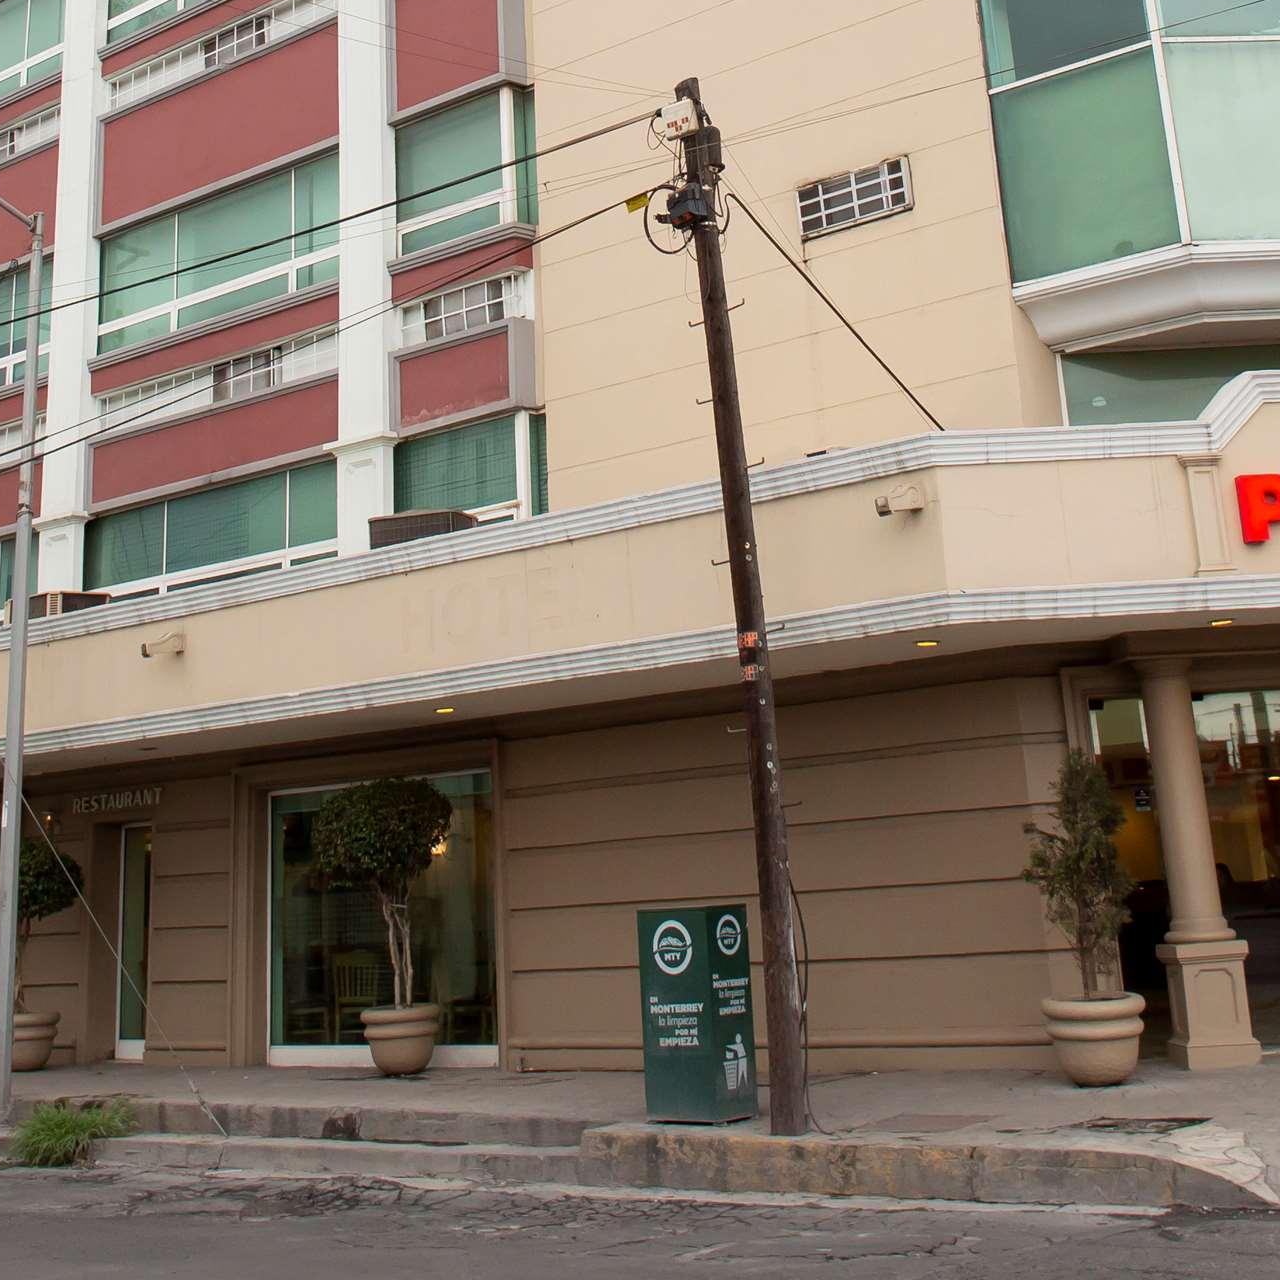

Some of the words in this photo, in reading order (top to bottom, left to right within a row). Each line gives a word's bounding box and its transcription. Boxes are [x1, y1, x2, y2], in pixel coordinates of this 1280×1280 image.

[72, 786, 163, 814] RESTAURANT
[713, 978, 748, 988] MONTERREY
[650, 1003, 704, 1013] MONTERREY
[667, 1014, 698, 1028] limpieza
[659, 1036, 699, 1047] EMPIEZA
